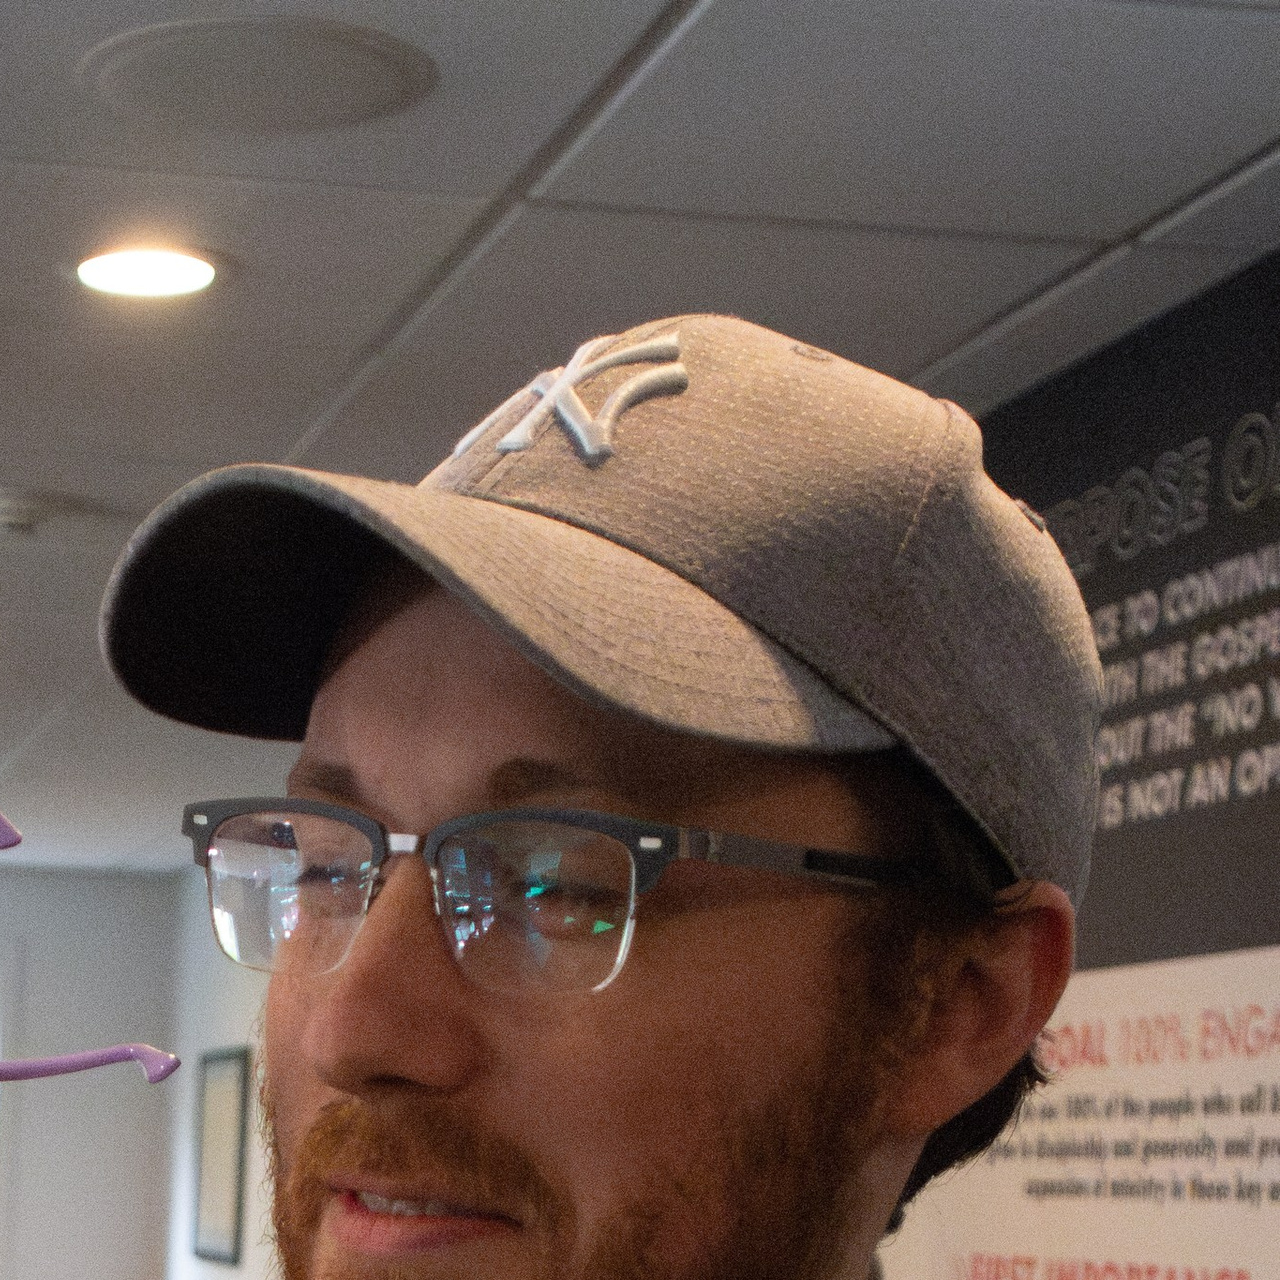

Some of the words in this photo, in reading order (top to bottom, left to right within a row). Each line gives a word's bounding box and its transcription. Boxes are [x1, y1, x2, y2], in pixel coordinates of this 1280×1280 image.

[1223, 404, 1280, 514] O
[1128, 768, 1184, 821] NOT
[1187, 756, 1232, 808] AN
